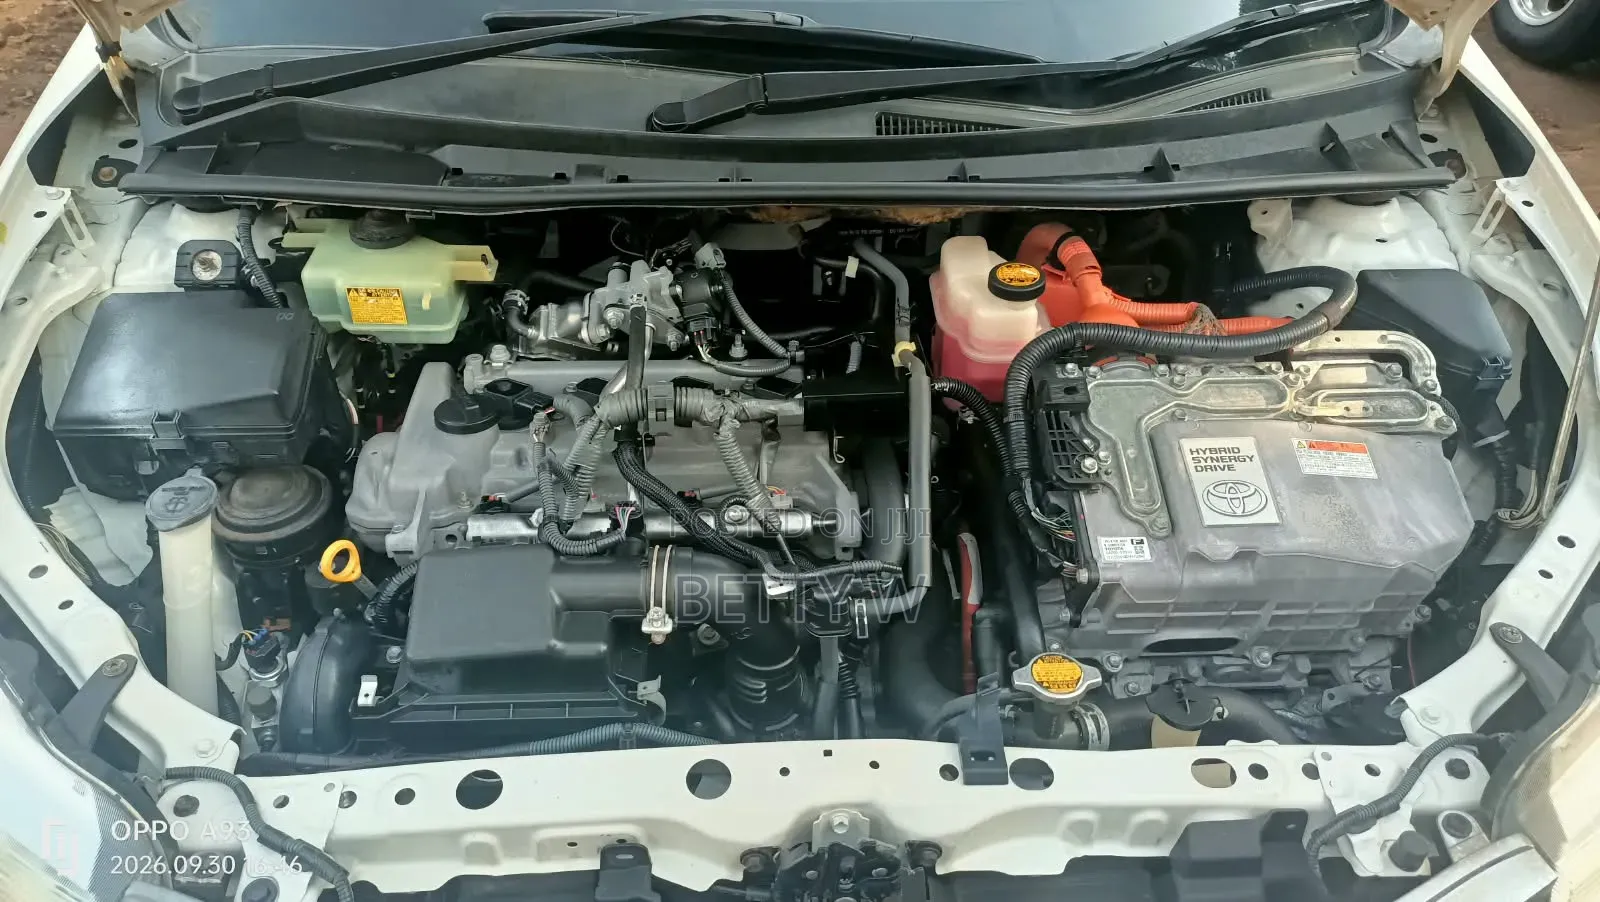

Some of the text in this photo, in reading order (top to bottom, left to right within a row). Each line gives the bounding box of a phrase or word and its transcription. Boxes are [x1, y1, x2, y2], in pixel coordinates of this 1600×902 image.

[1189, 446, 1241, 456] HYBRID
[1191, 454, 1255, 464] SYNERGY
[1194, 464, 1236, 472] DRIVE
